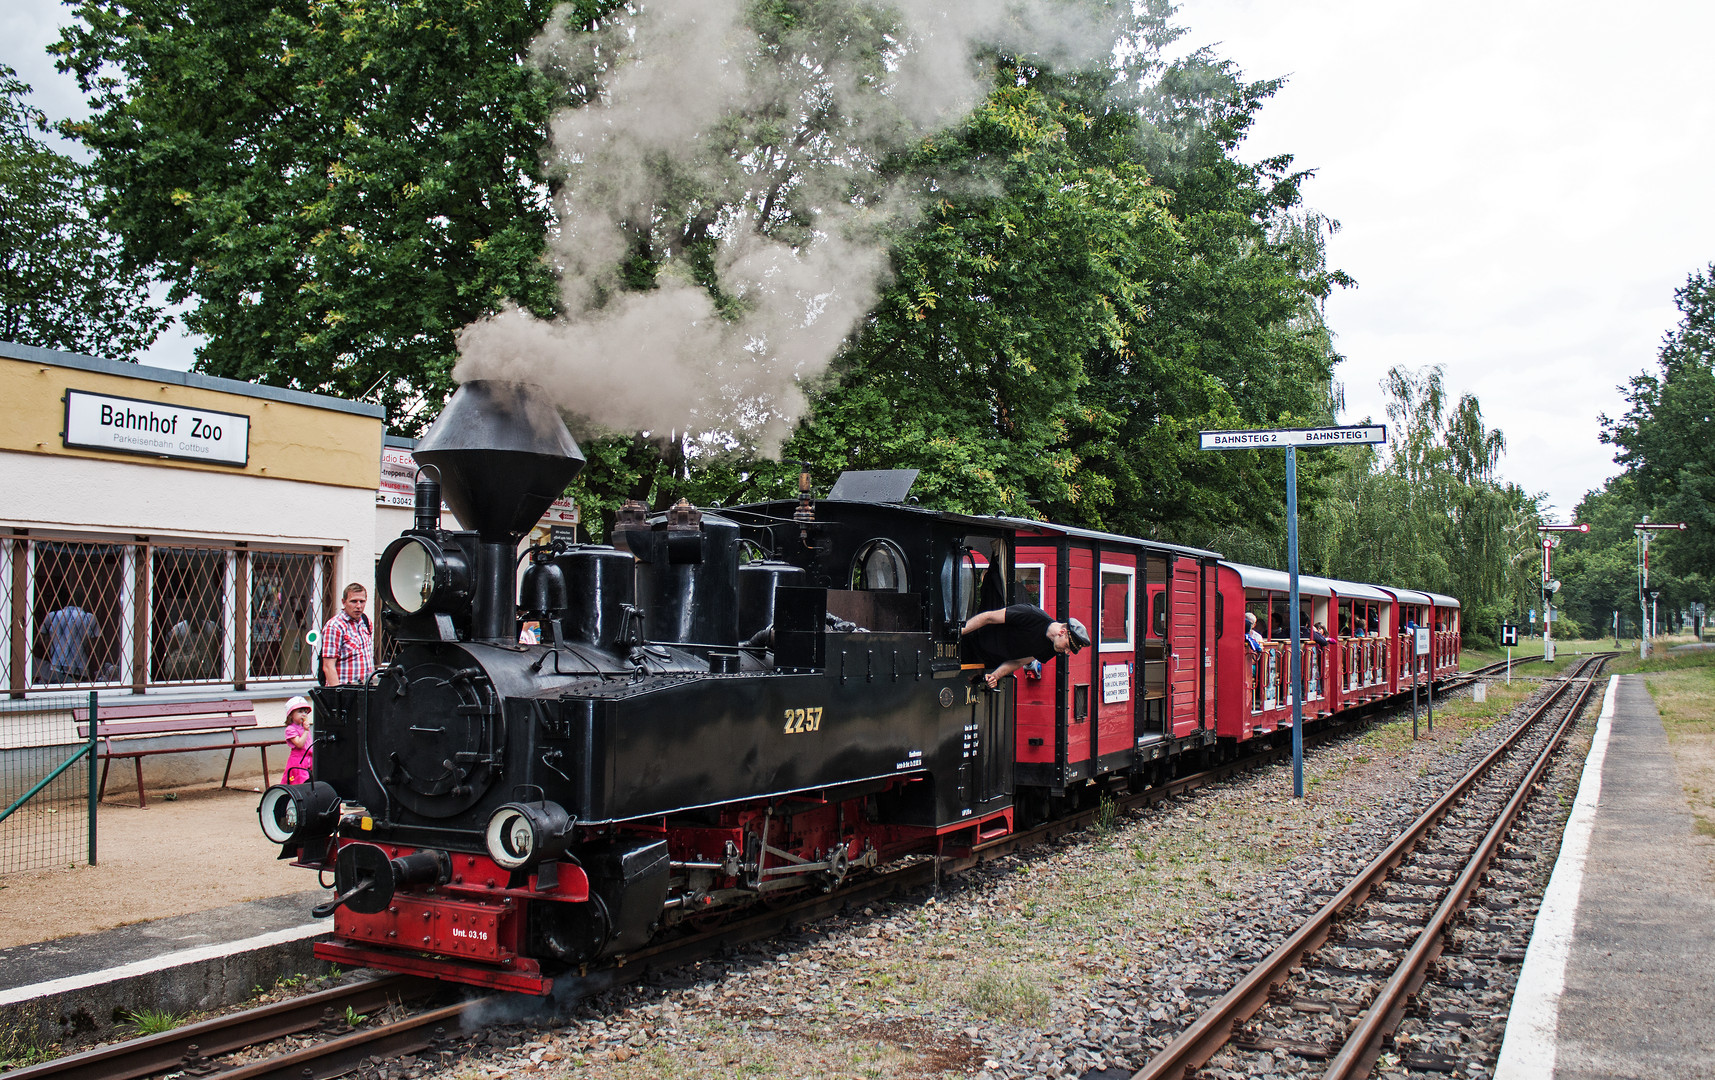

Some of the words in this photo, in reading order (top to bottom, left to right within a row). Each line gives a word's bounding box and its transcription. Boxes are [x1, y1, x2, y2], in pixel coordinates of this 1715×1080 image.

[100, 404, 178, 435] Bahnhof
[190, 417, 222, 441] Zoo
[113, 433, 174, 449] Parkeisenbahn
[178, 441, 210, 454] Cottbus
[1214, 435, 1269, 444] BAHNSTEIG
[1306, 431, 1362, 441] BAHNSTEIG
[1363, 431, 1368, 439] 1
[392, 496, 412, 506] 03042
[1502, 626, 1517, 644] H
[783, 706, 823, 735] 2257
[452, 927, 468, 938] Unt.
[468, 930, 488, 941] 03.16
